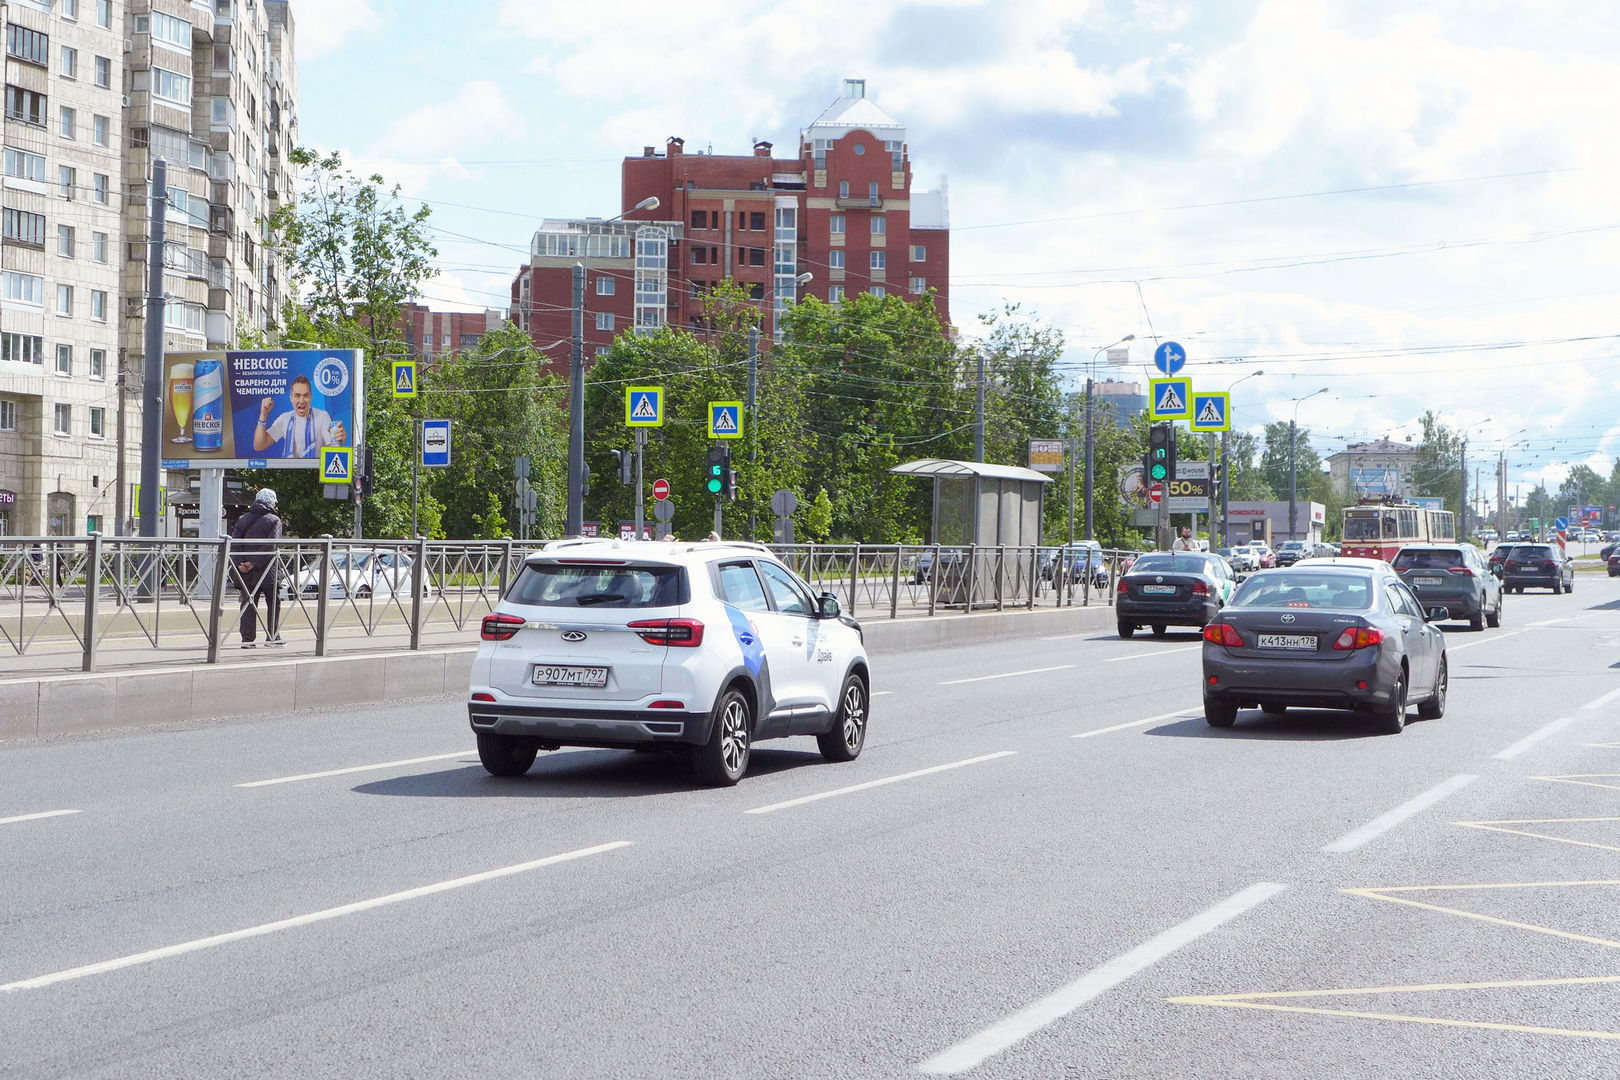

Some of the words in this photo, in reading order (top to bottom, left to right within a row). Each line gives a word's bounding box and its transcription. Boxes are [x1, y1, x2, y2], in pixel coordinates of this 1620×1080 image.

[233, 357, 288, 370] НЕВСКОЕ
[234, 379, 270, 387] СВАРЕНО
[270, 378, 287, 387] ДЛЯ
[236, 387, 285, 395] ЧЕМПИОНОВ
[194, 421, 221, 429] НЕВСКОЕ
[1169, 480, 1203, 495] 50%
[1300, 637, 1316, 645] 178
[585, 668, 604, 679] 797
